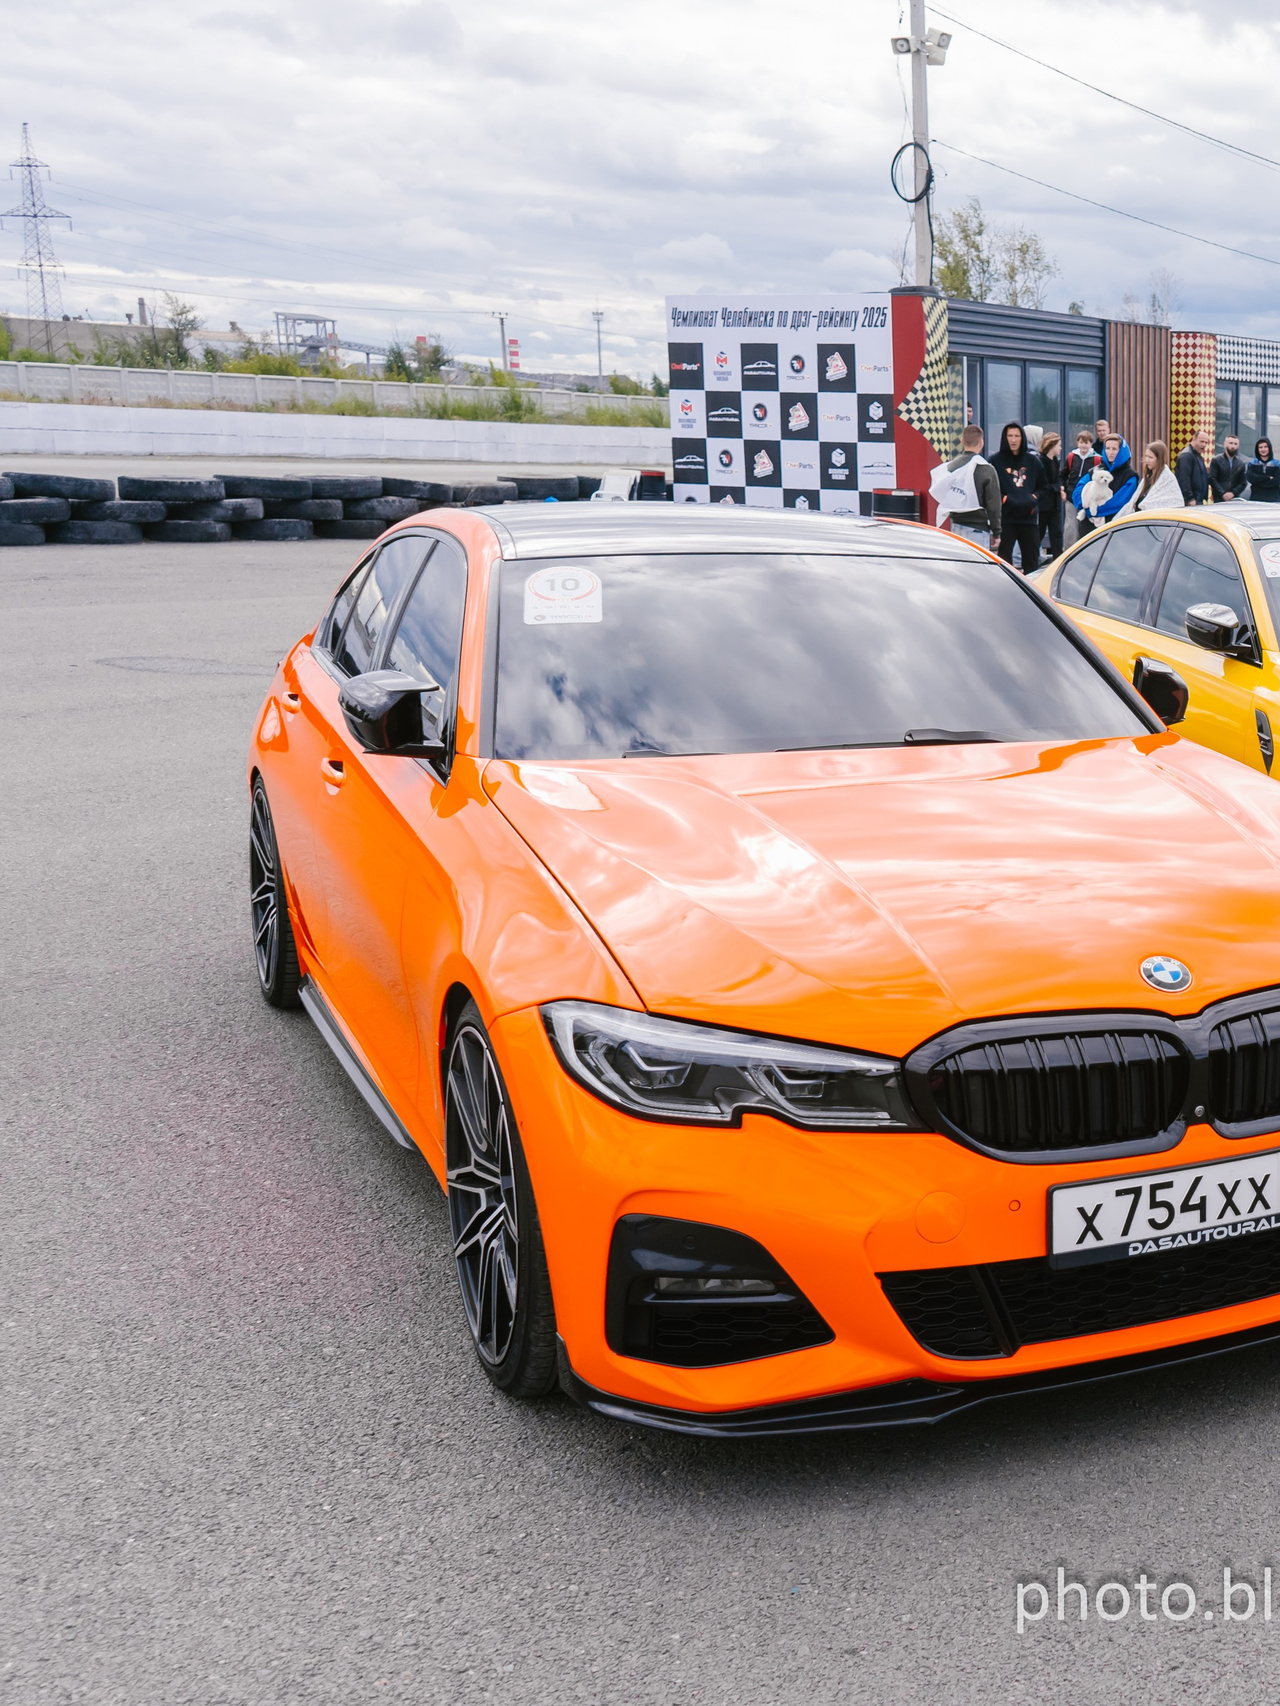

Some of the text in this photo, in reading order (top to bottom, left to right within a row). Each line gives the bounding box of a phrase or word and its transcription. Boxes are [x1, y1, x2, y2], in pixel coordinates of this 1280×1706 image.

[671, 306, 888, 331] Чемпионат Челябинска по дрэг-рейсингу 2025
[545, 578, 580, 591] 10
